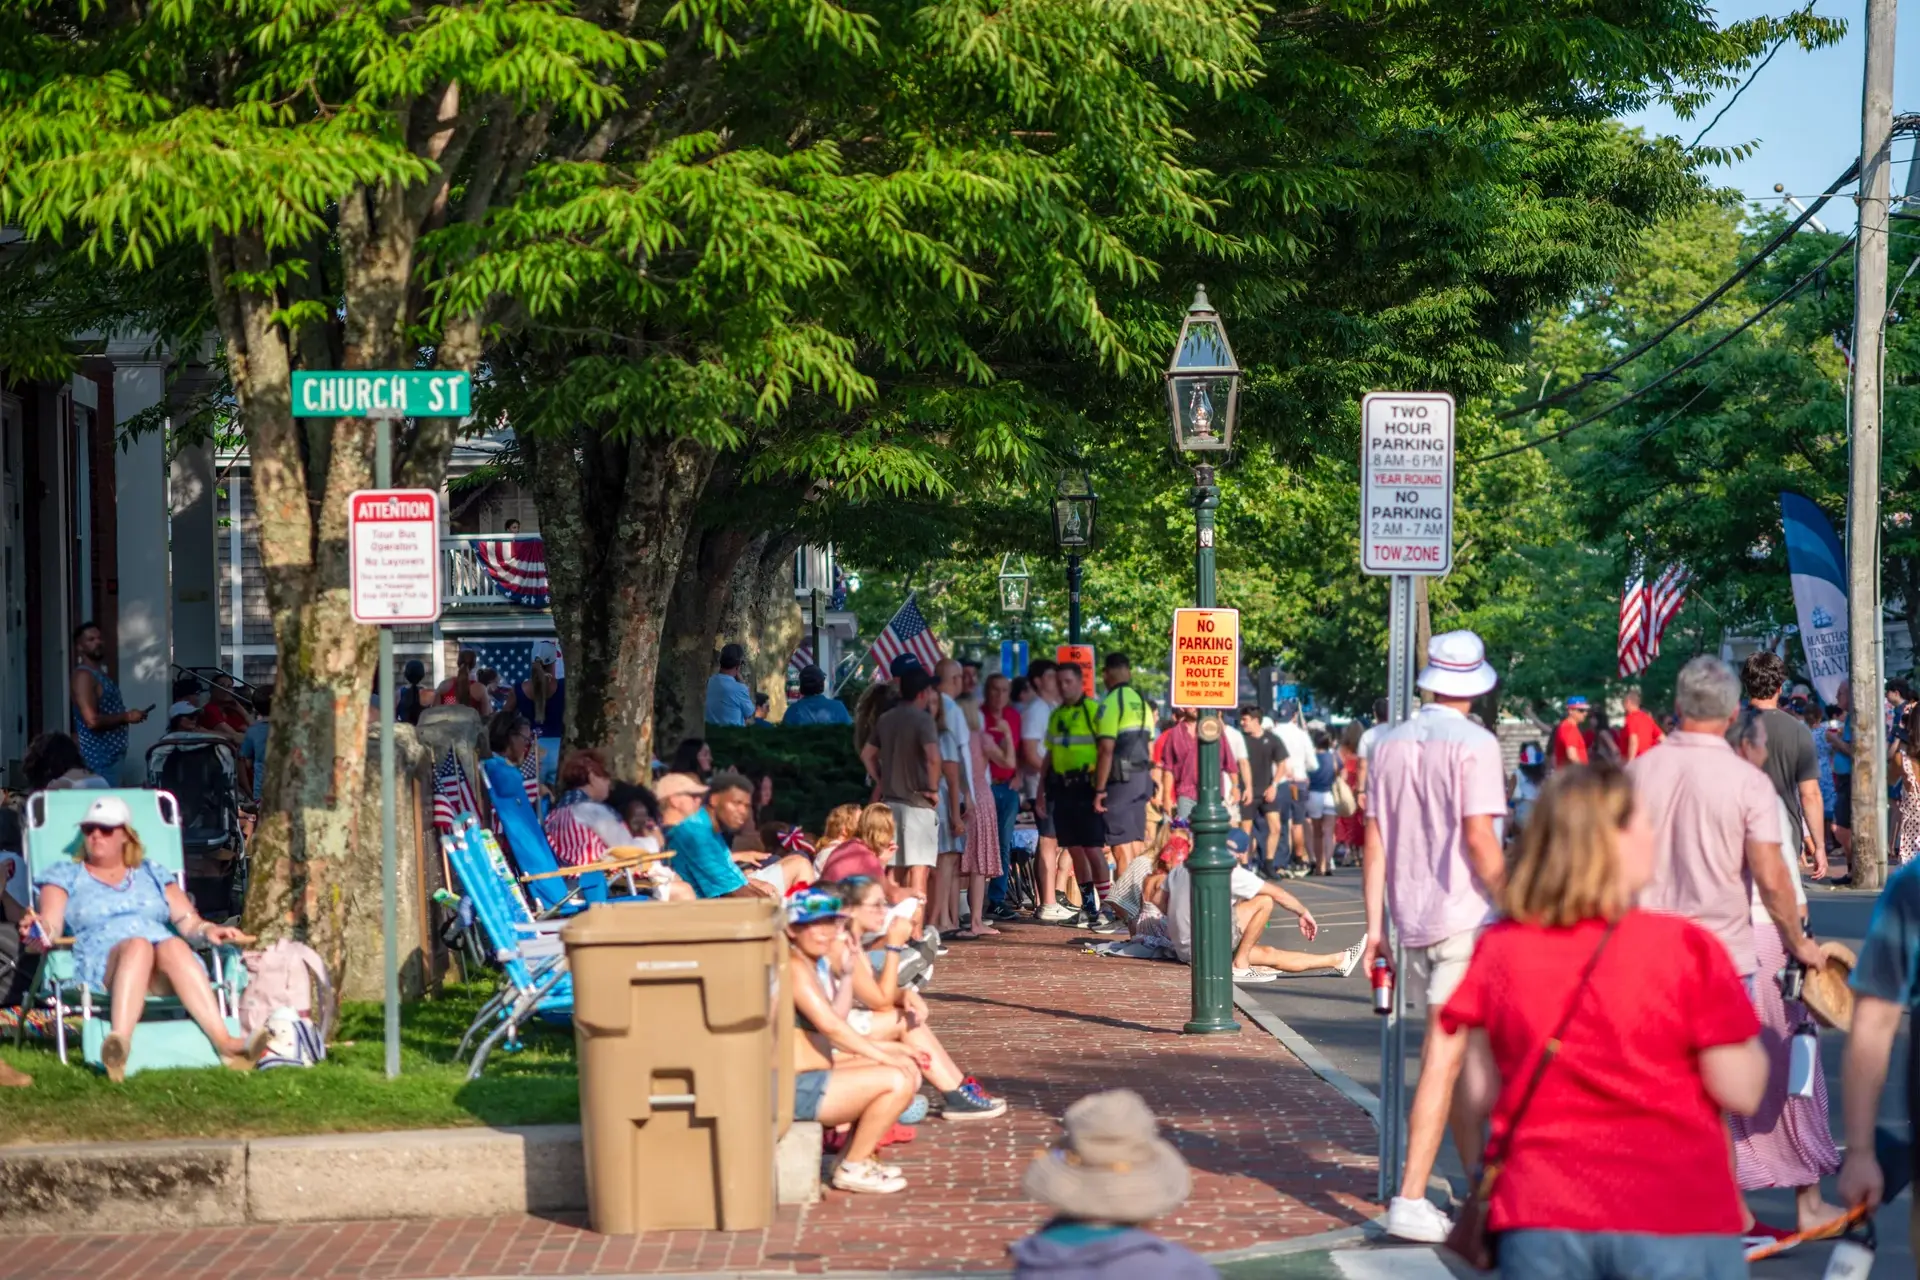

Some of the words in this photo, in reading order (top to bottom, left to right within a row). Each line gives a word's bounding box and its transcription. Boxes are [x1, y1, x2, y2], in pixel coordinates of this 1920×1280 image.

[303, 377, 407, 411] CHURCH
[428, 376, 465, 411] ST
[1390, 405, 1428, 418] TWO
[1385, 422, 1431, 434] HOUR
[1372, 438, 1444, 450] PARKING
[1373, 454, 1381, 467] 8
[1423, 455, 1443, 467] PM
[1374, 473, 1402, 484] YEAR
[1404, 474, 1442, 485] ROUND
[1395, 490, 1419, 503] NO
[358, 501, 430, 519] ATTENTION
[1372, 506, 1442, 519] PARKING
[1372, 522, 1380, 535] 2
[1383, 522, 1402, 535] AM
[1424, 523, 1443, 535] AM
[1374, 545, 1402, 560] TOW
[1404, 546, 1440, 561] ZONE
[1197, 619, 1214, 632] NO
[1179, 637, 1233, 650] PARKING
[1182, 655, 1229, 666] PARADE
[1186, 668, 1225, 678] ROUTE
